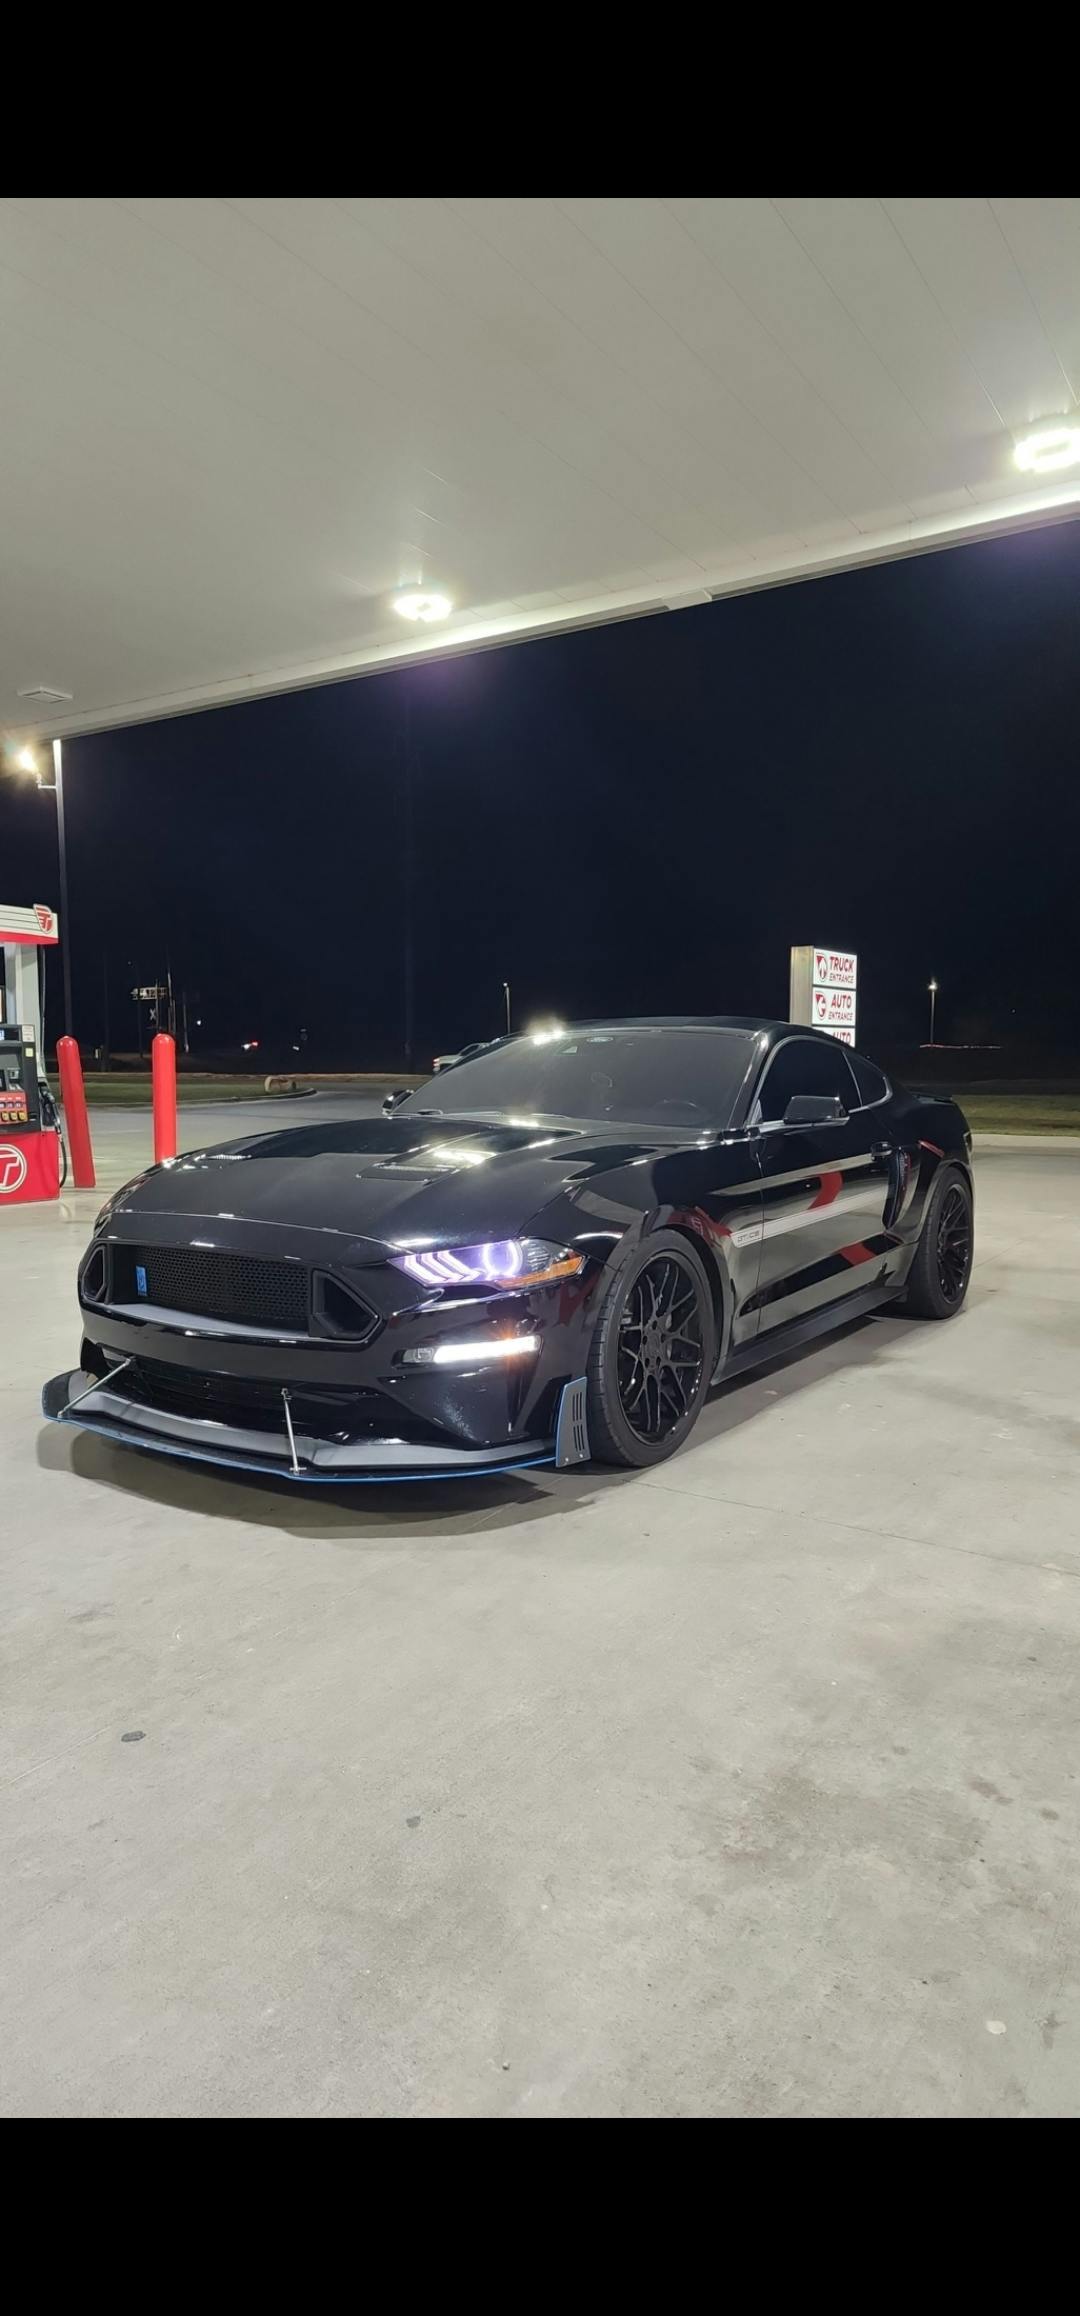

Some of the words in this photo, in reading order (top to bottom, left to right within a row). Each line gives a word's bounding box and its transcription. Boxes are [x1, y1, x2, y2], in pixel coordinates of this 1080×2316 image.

[830, 956, 855, 973] TRUCK
[828, 973, 854, 984] ENTRANCE
[831, 993, 852, 1009] AUTO
[828, 1009, 853, 1021] ENTRANCE
